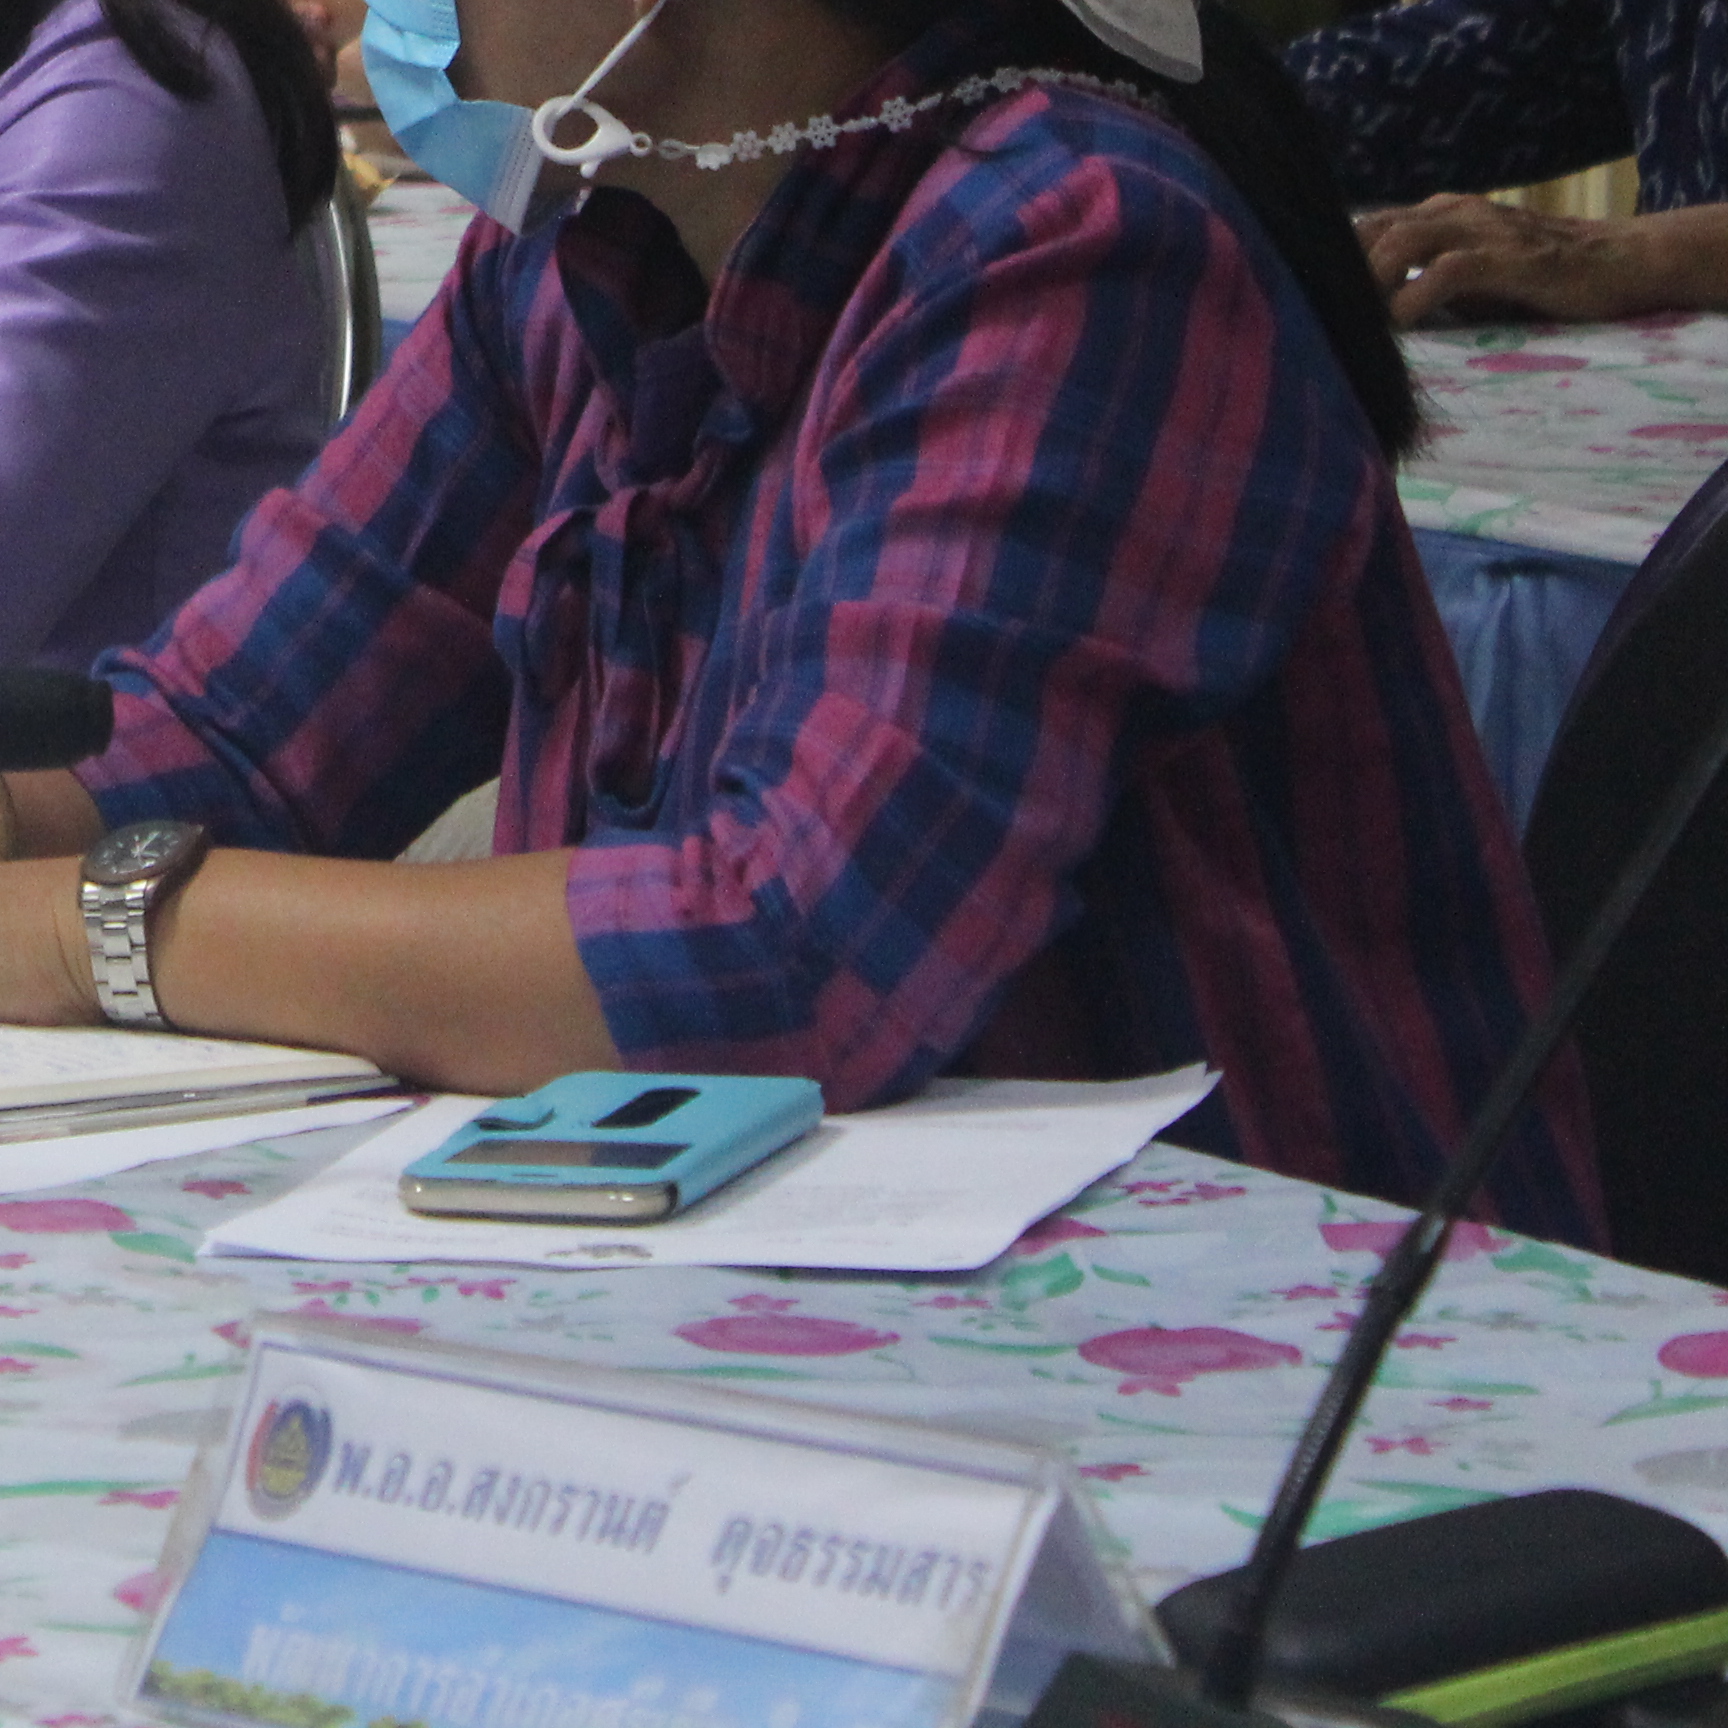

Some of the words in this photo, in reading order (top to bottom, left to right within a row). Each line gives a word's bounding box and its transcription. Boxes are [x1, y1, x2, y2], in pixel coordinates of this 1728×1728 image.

[330, 1438, 692, 1556] พ.อ.อ.สงกรานต์
